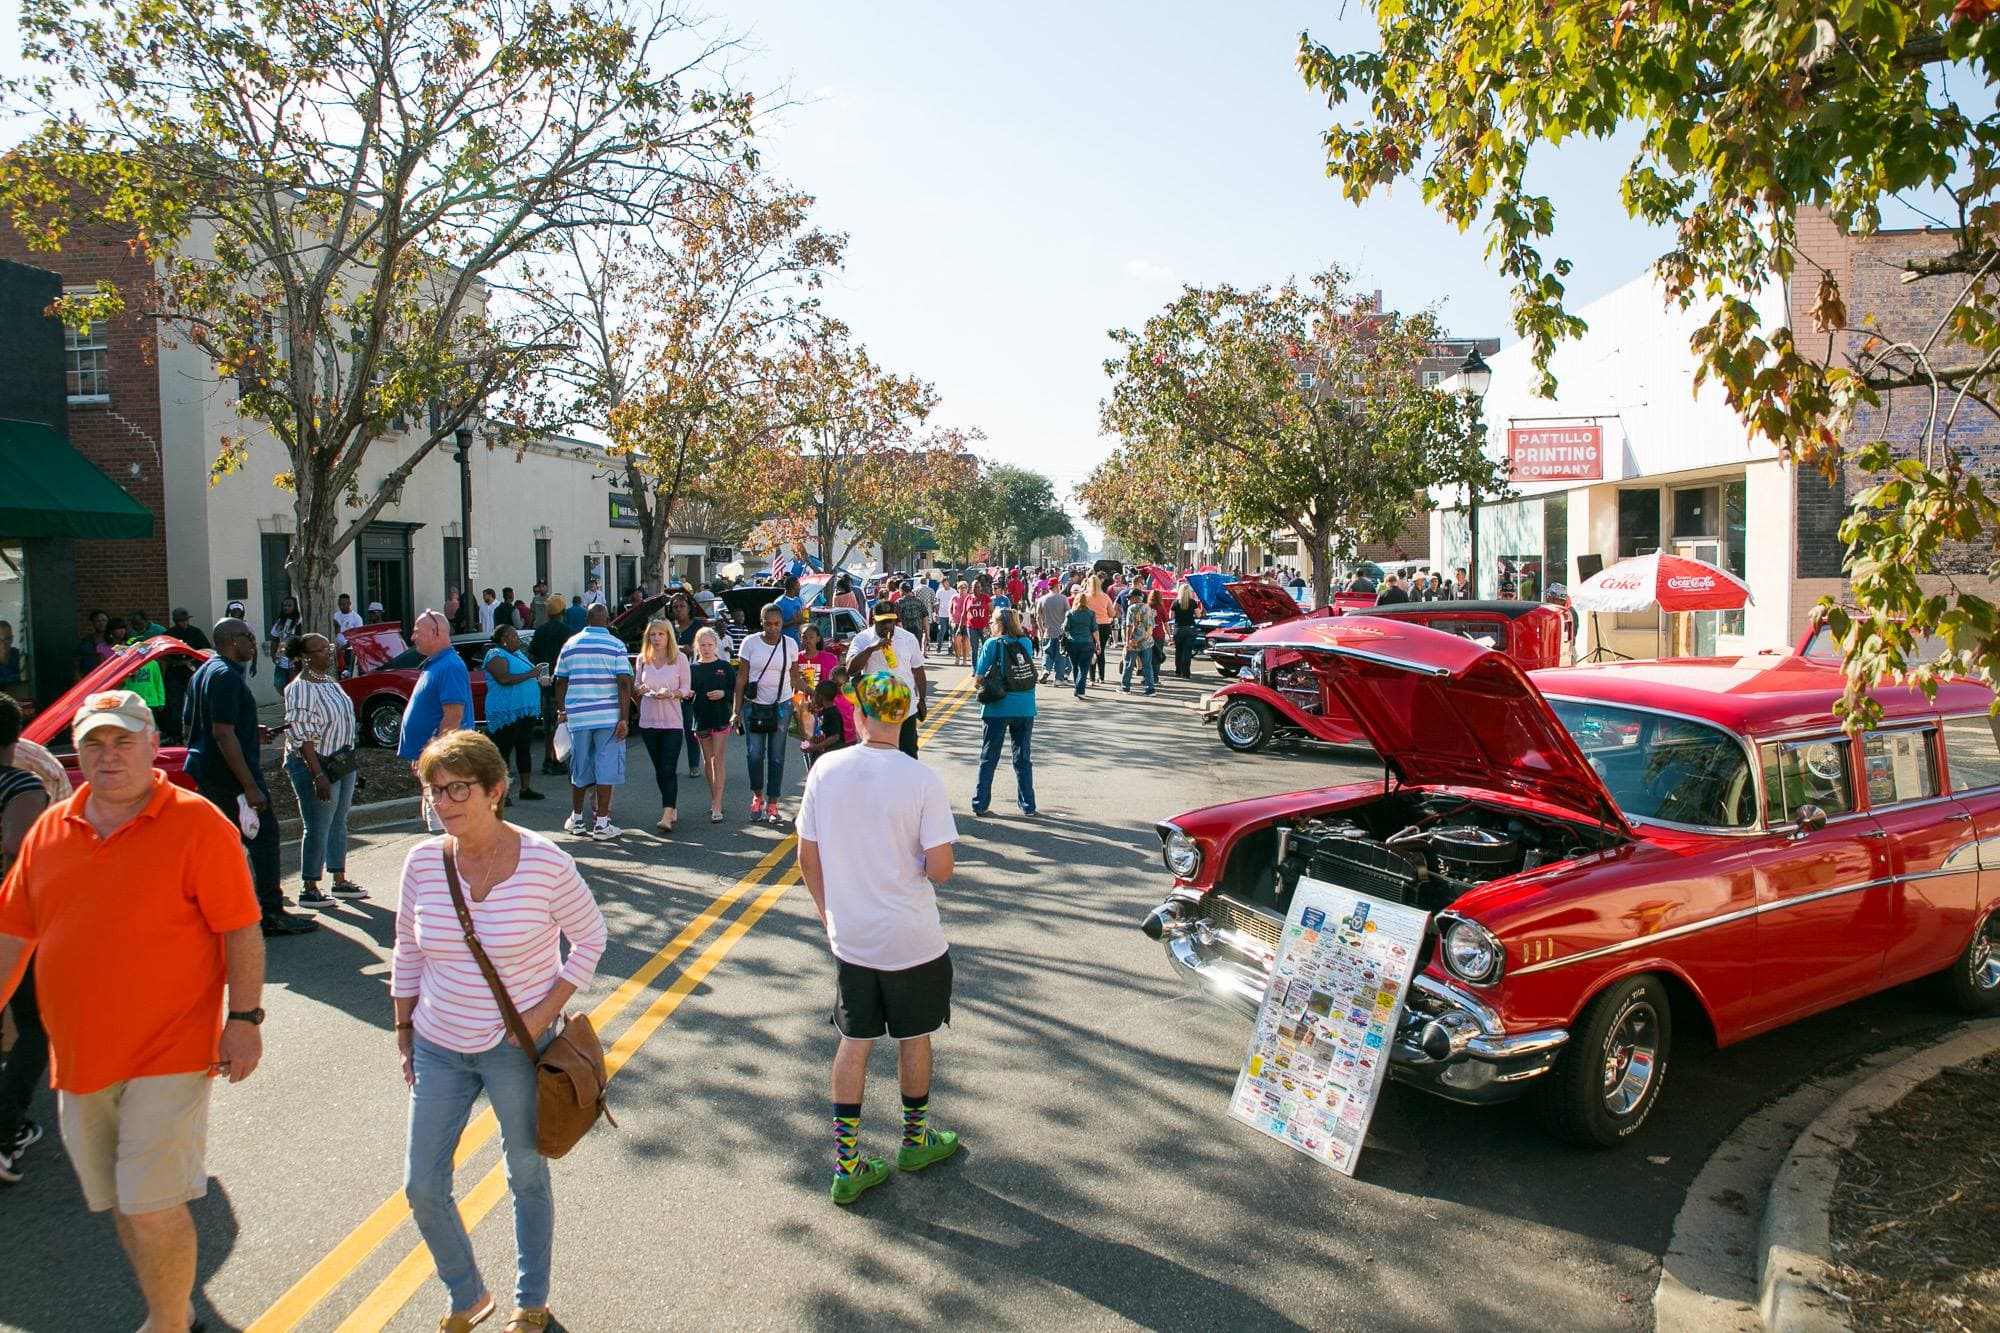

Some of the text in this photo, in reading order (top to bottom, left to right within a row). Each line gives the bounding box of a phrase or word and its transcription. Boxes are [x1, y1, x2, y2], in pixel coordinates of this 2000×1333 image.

[1519, 432, 1593, 444] PATTILLO
[1514, 446, 1597, 462] PRINTING
[1521, 464, 1591, 475] COMPANY
[1600, 578, 1641, 590] Coke
[1667, 576, 1716, 589] Coca-Cola
